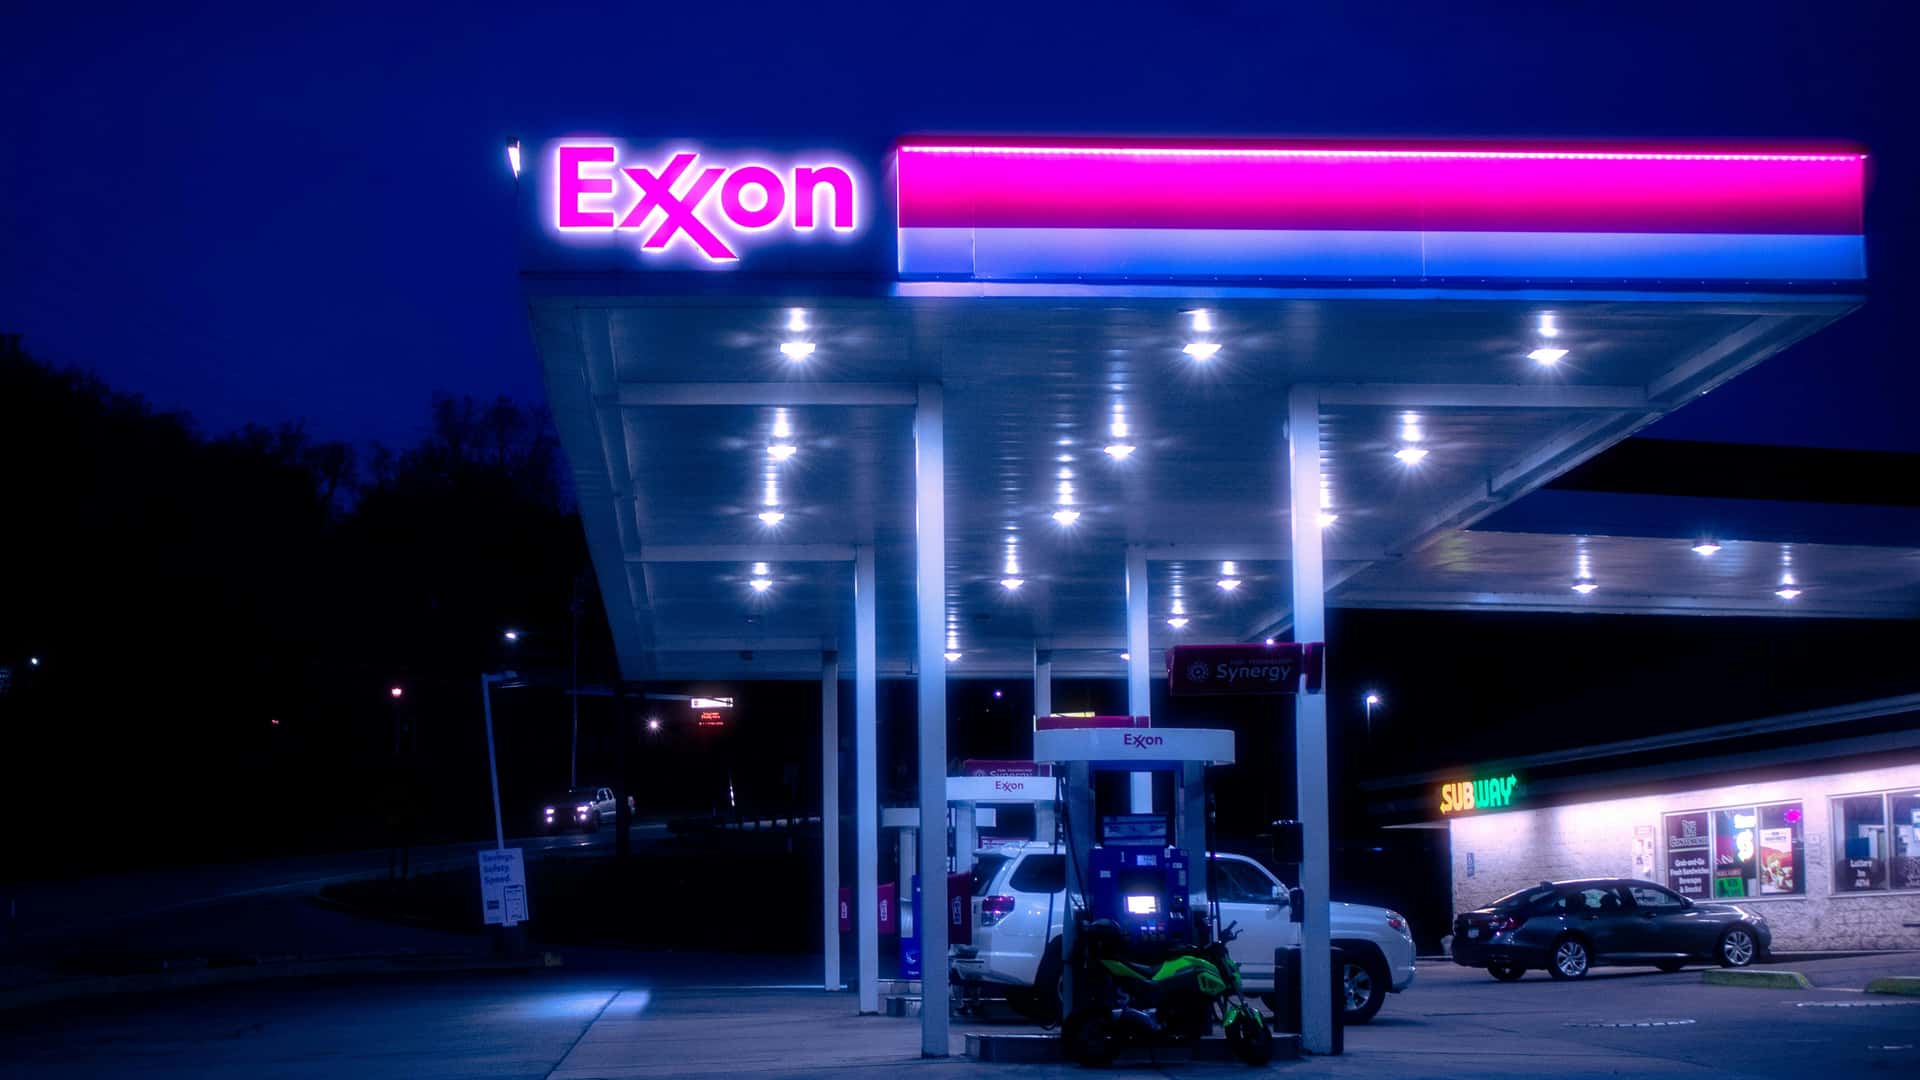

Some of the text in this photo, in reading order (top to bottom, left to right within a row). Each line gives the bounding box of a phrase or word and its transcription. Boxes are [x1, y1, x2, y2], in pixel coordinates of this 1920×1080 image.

[557, 145, 856, 261] Exxon
[1216, 663, 1290, 683] Synergy
[1124, 733, 1164, 749] Exxon
[995, 780, 1024, 792] Exxon
[1440, 774, 1517, 814] SUBWAY
